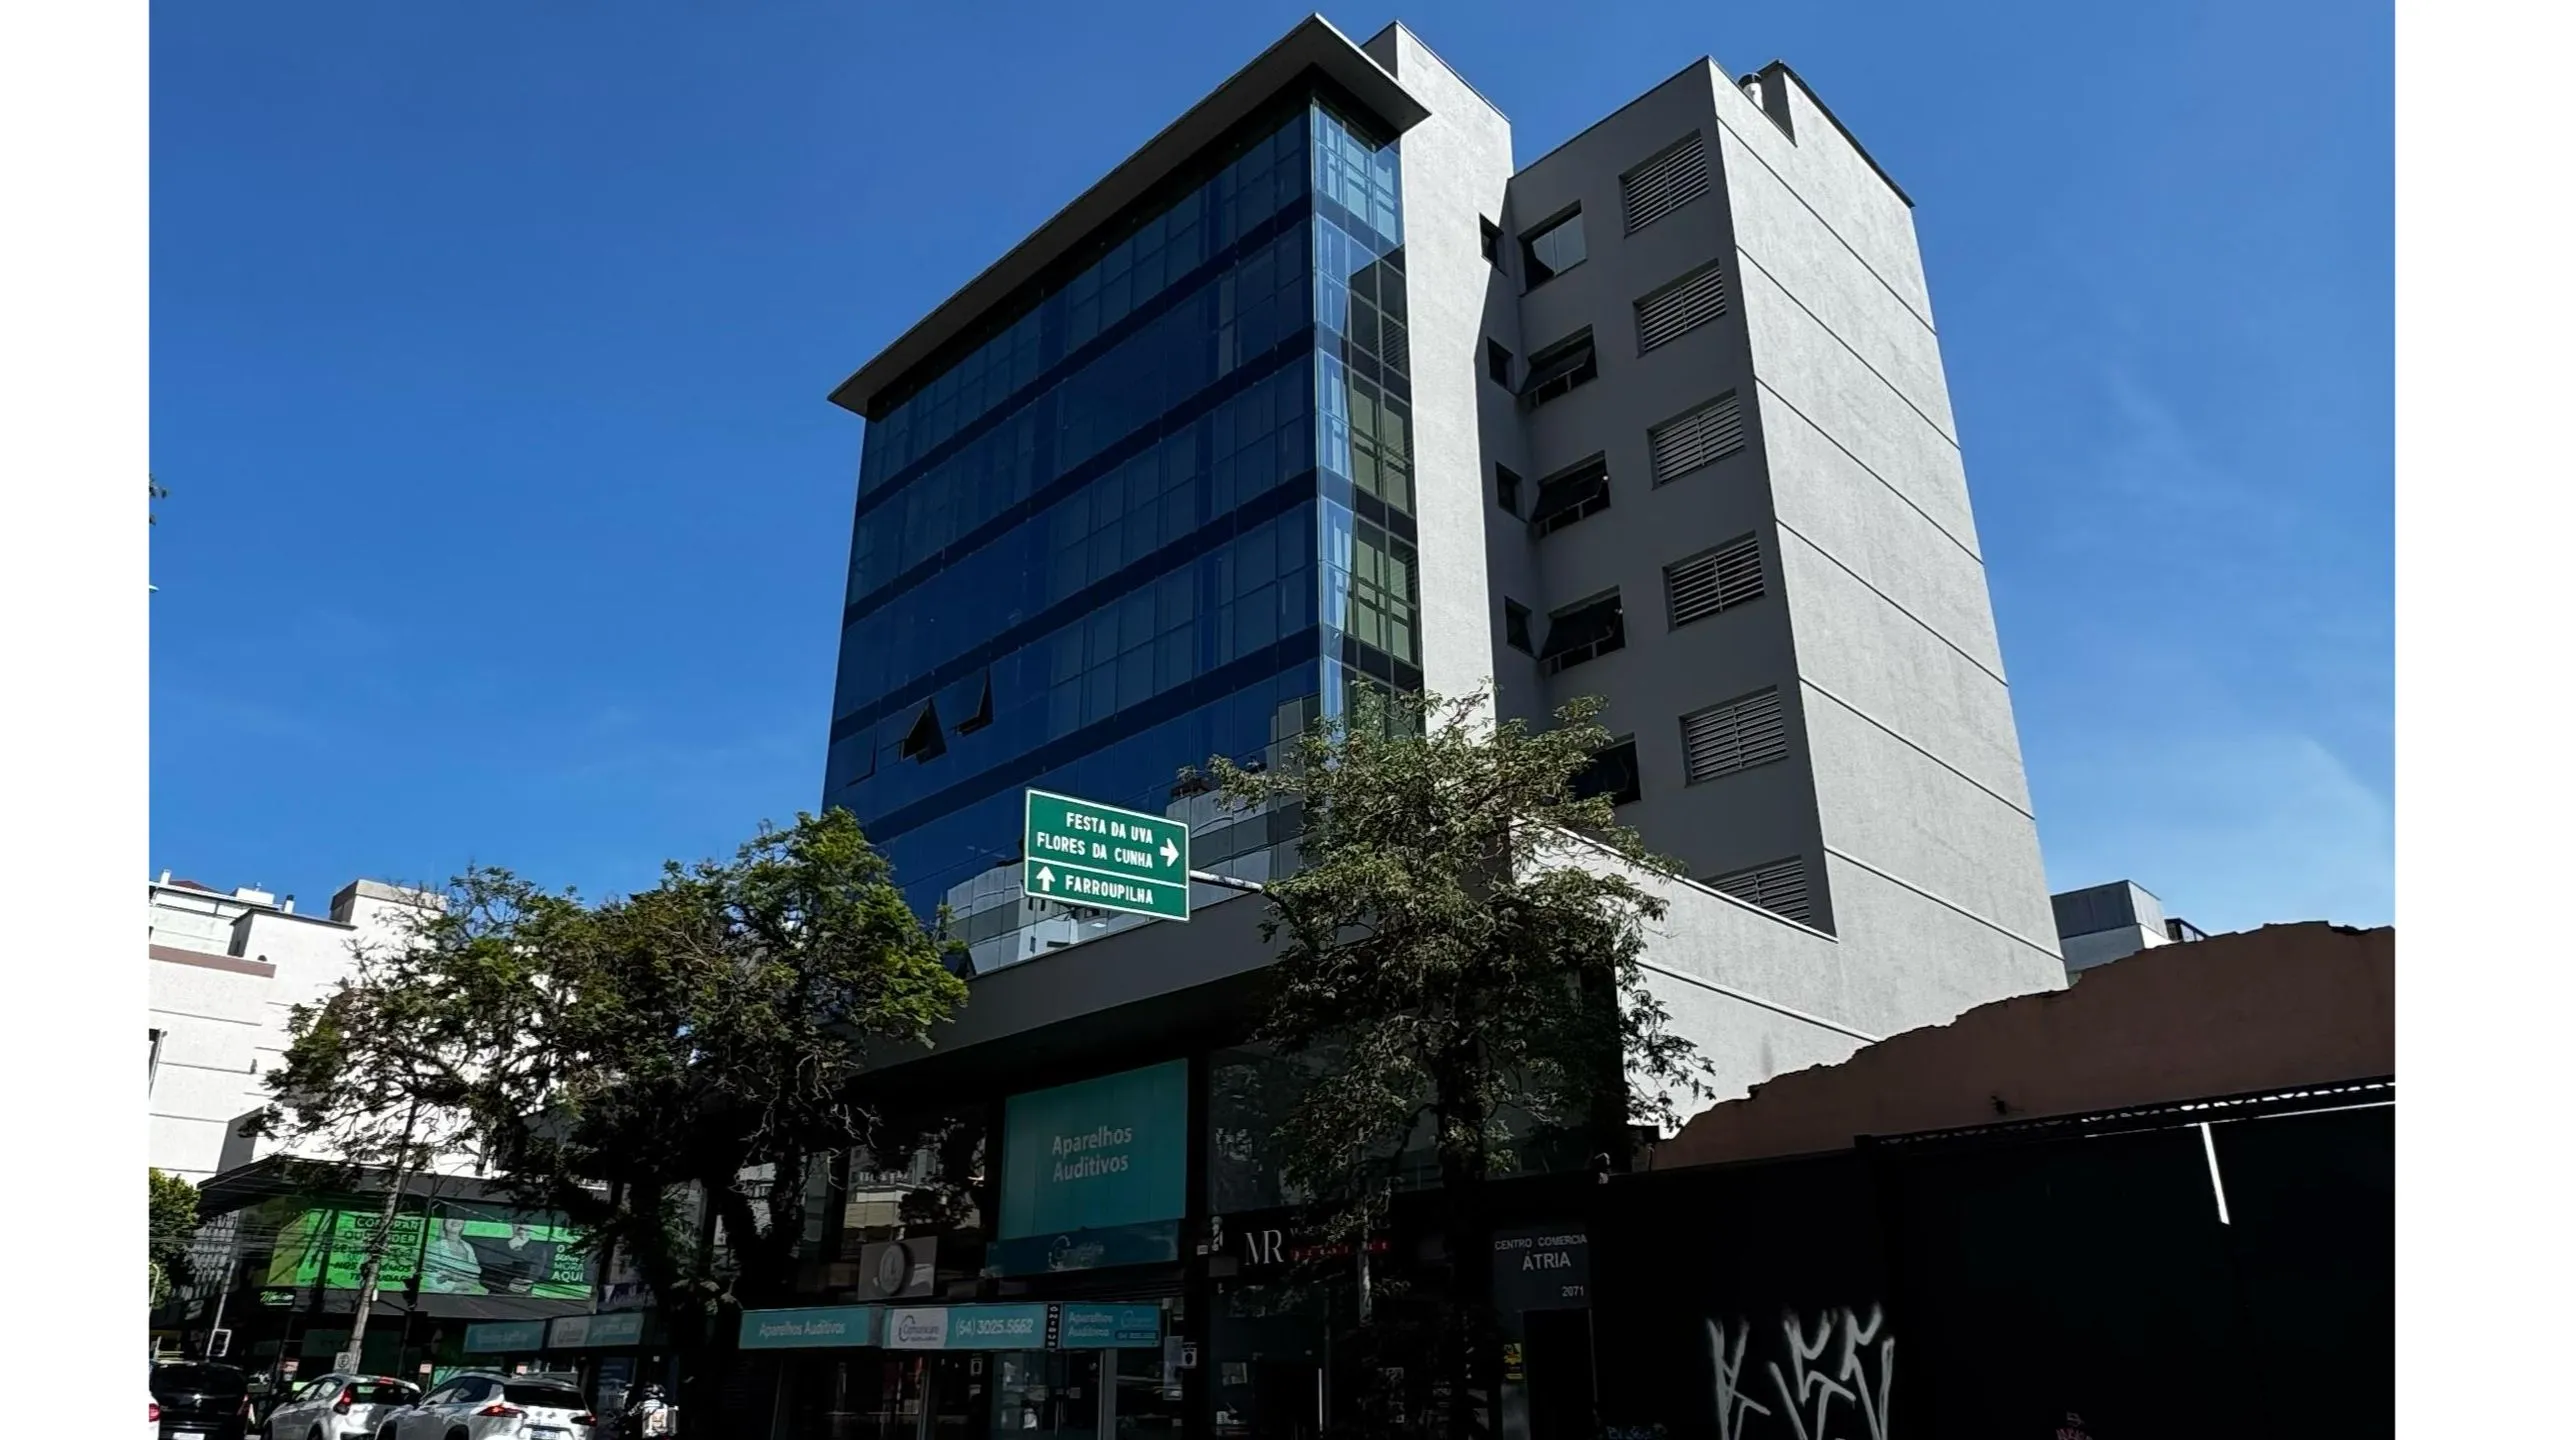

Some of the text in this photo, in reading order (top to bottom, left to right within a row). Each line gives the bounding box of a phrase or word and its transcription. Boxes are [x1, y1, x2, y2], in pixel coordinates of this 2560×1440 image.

[1066, 812, 1153, 845] FESTA DA UVA
[1036, 832, 1153, 869] FLORES DA CUNHA
[1065, 875, 1153, 905] FARROUPILHA
[1052, 1125, 1132, 1160] Aparelhos
[1053, 1153, 1129, 1183] Auditivos
[1243, 1229, 1285, 1266] MR
[1494, 1238, 1533, 1250] CENTRO
[1522, 1250, 1572, 1271] ÁTRIA
[1561, 1285, 1585, 1297] 2071
